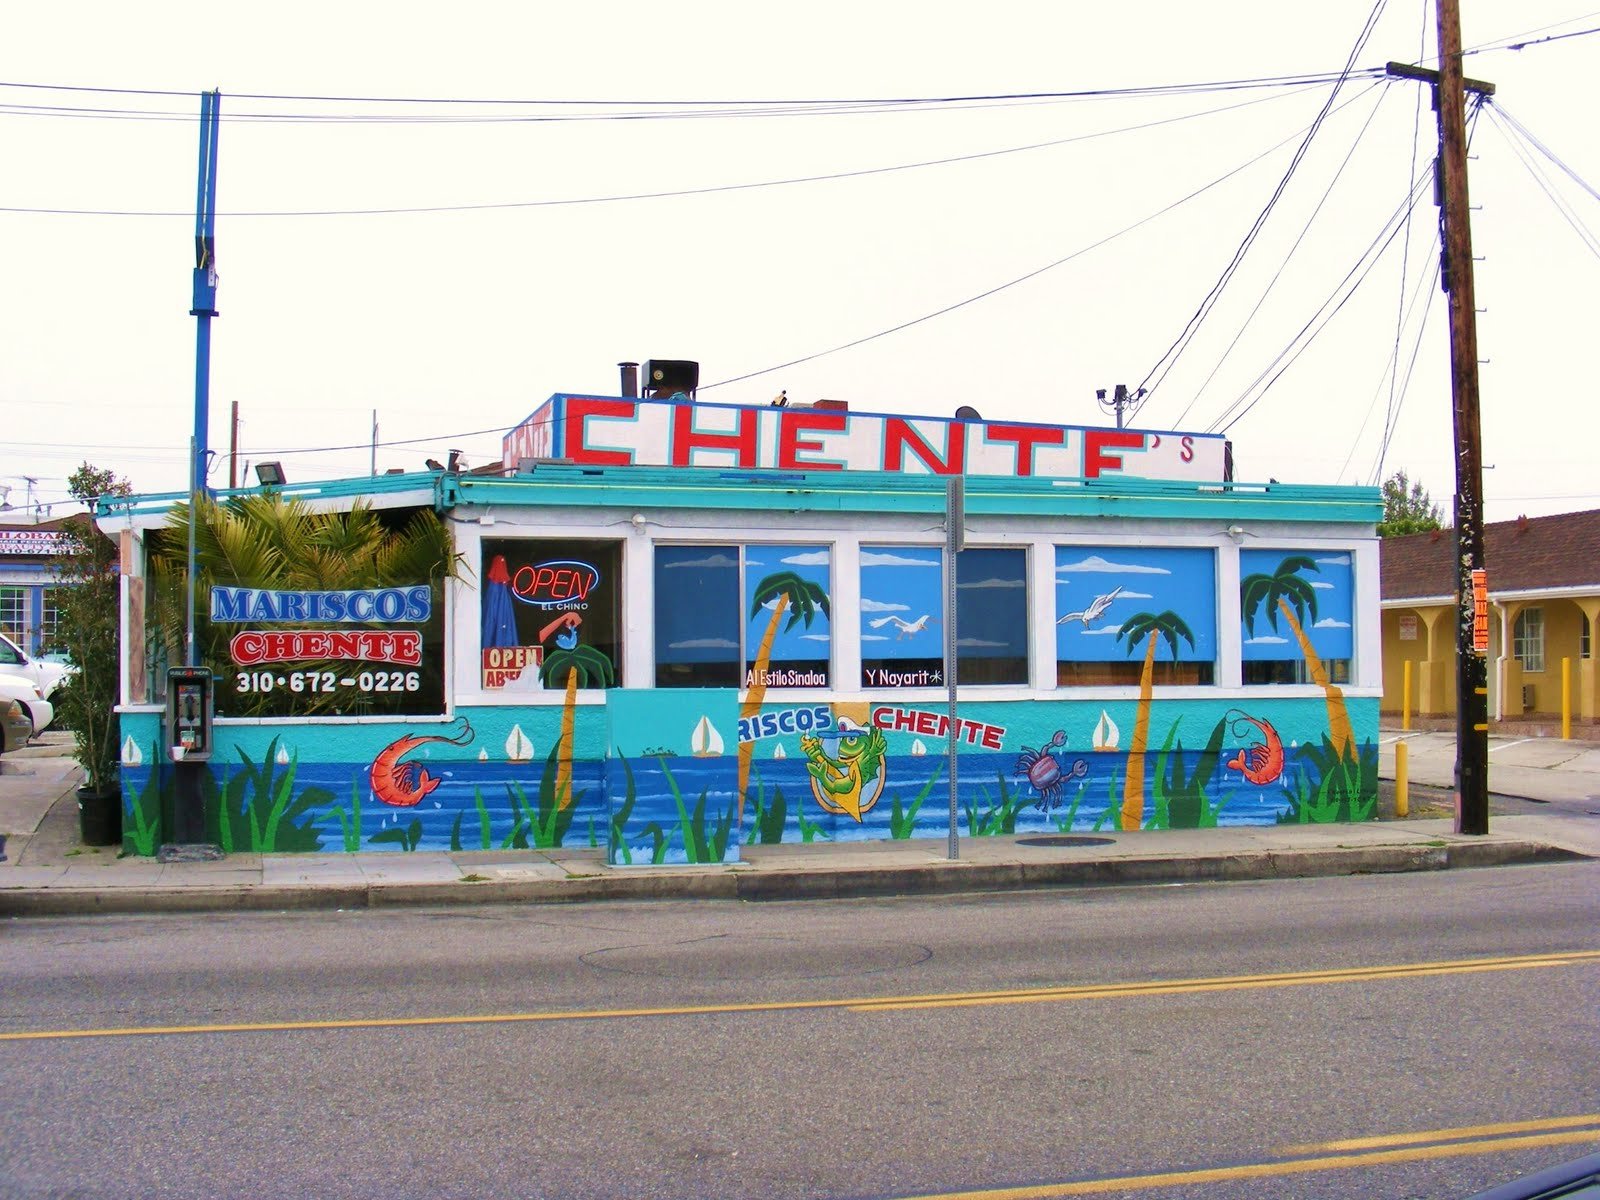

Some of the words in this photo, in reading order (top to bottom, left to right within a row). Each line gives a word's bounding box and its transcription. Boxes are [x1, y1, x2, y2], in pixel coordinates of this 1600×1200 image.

[565, 398, 1194, 478] CHENTE'S
[513, 566, 592, 600] OPEN
[212, 586, 431, 622] MARISCOS
[556, 603, 589, 611] CHINO
[232, 631, 421, 664] CHENTE
[489, 648, 538, 668] OPEN
[746, 670, 758, 686] Al
[866, 669, 877, 685] Y
[879, 669, 930, 688] Nayarit
[738, 707, 831, 740] RISCOS
[873, 707, 1006, 750] CHENTE
